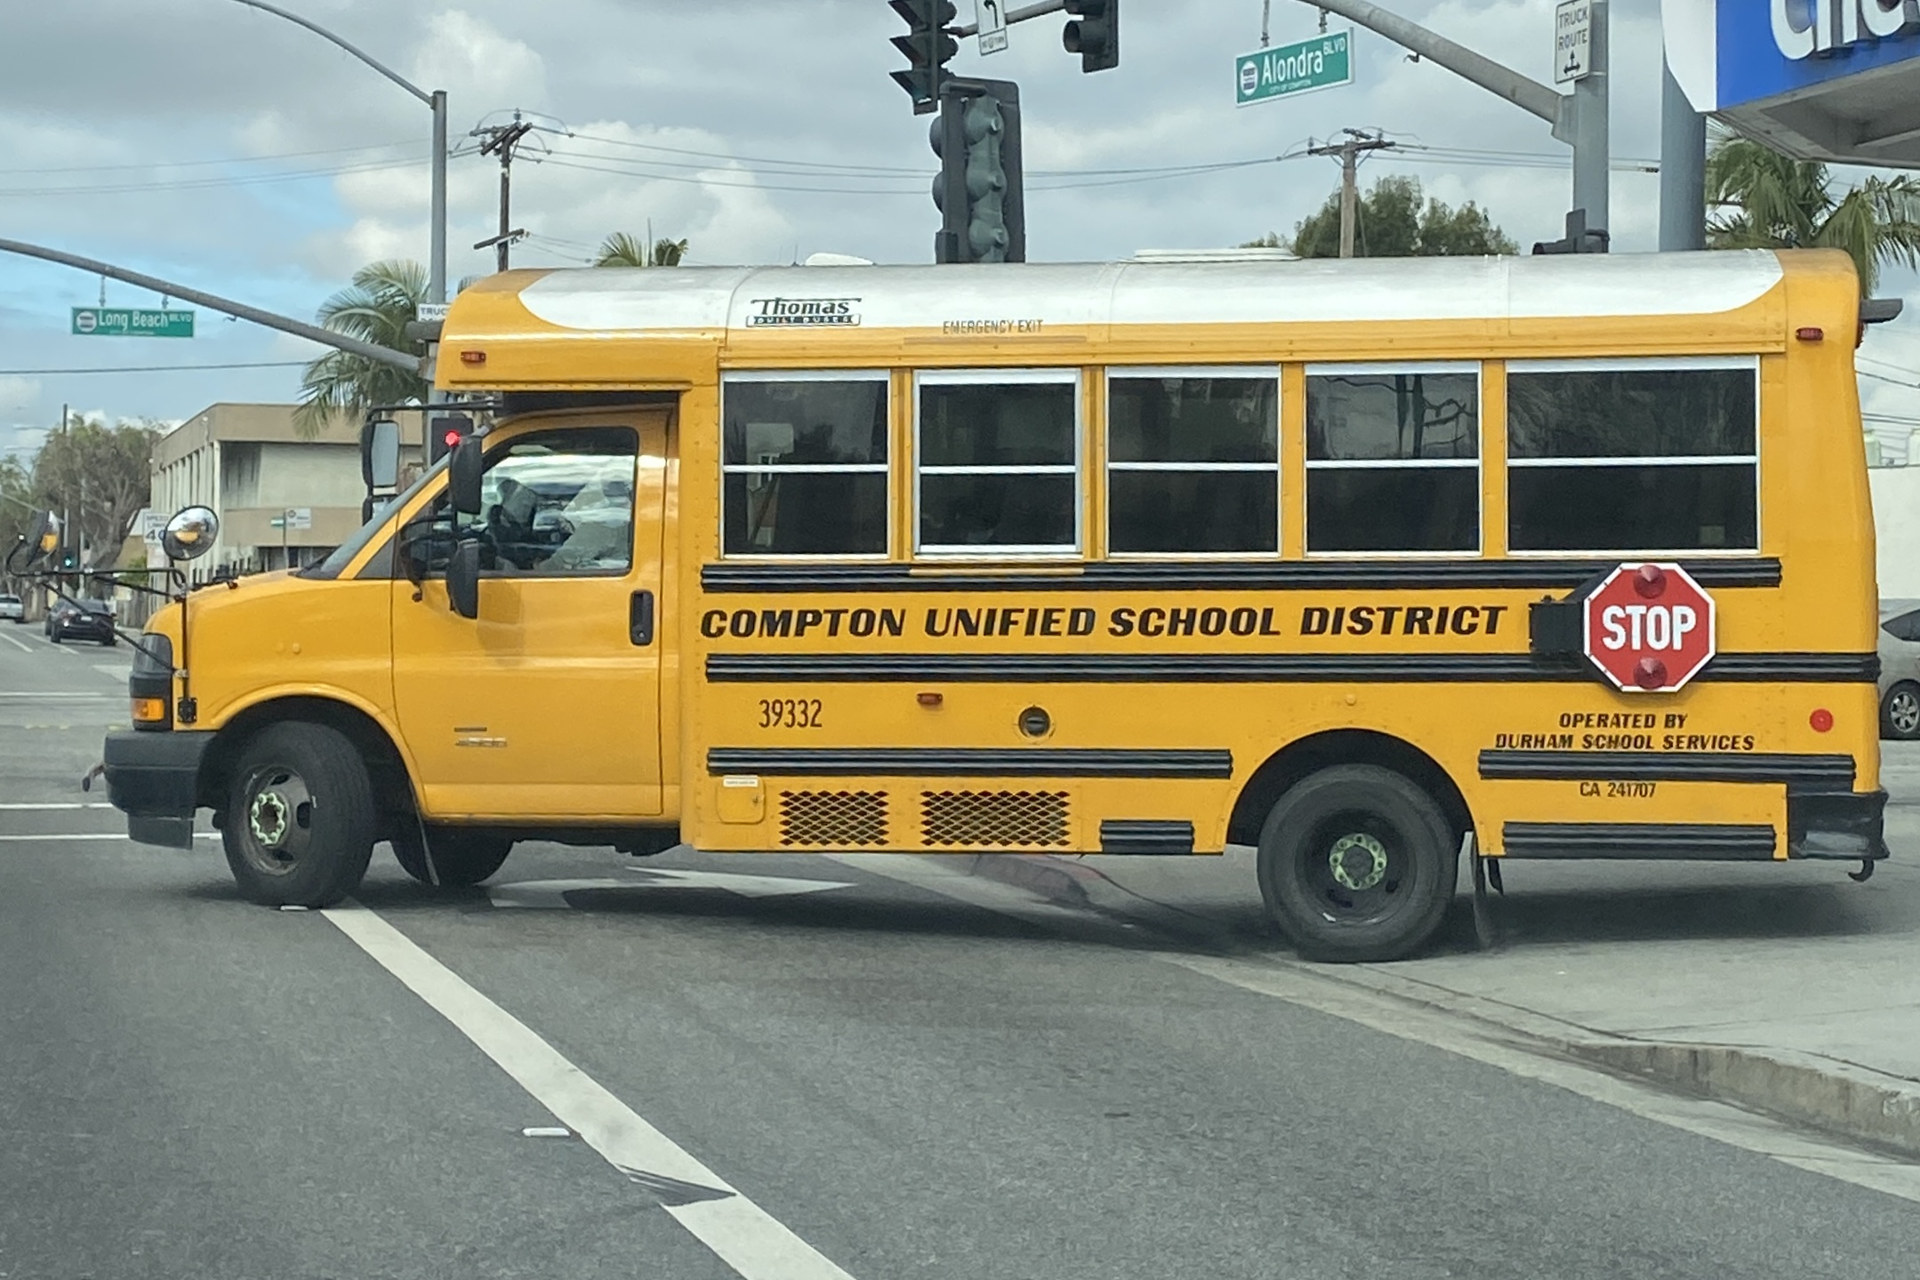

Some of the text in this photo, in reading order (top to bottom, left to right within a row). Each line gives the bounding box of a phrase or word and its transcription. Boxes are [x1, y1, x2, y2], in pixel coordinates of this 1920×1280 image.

[1559, 7, 1588, 28] TRUCK
[1558, 28, 1587, 51] ROUTE
[1262, 46, 1323, 86] Alondra
[1323, 37, 1346, 55] BLVD
[421, 307, 449, 316] TRUC
[751, 297, 861, 315] Thomas
[99, 310, 192, 331] Long Beach BLVD
[943, 319, 1043, 335] EMERGENCY EXIT
[701, 605, 1508, 638] COMPTON UNIFIED SCHOOL DISTRICT
[1602, 605, 1697, 651] STOP
[758, 699, 823, 729] 39332
[1559, 712, 1688, 729] OPERATED BY
[1495, 733, 1755, 751] DURHAM SCHOOL SERVICES
[1580, 782, 1656, 798] CA 241707
